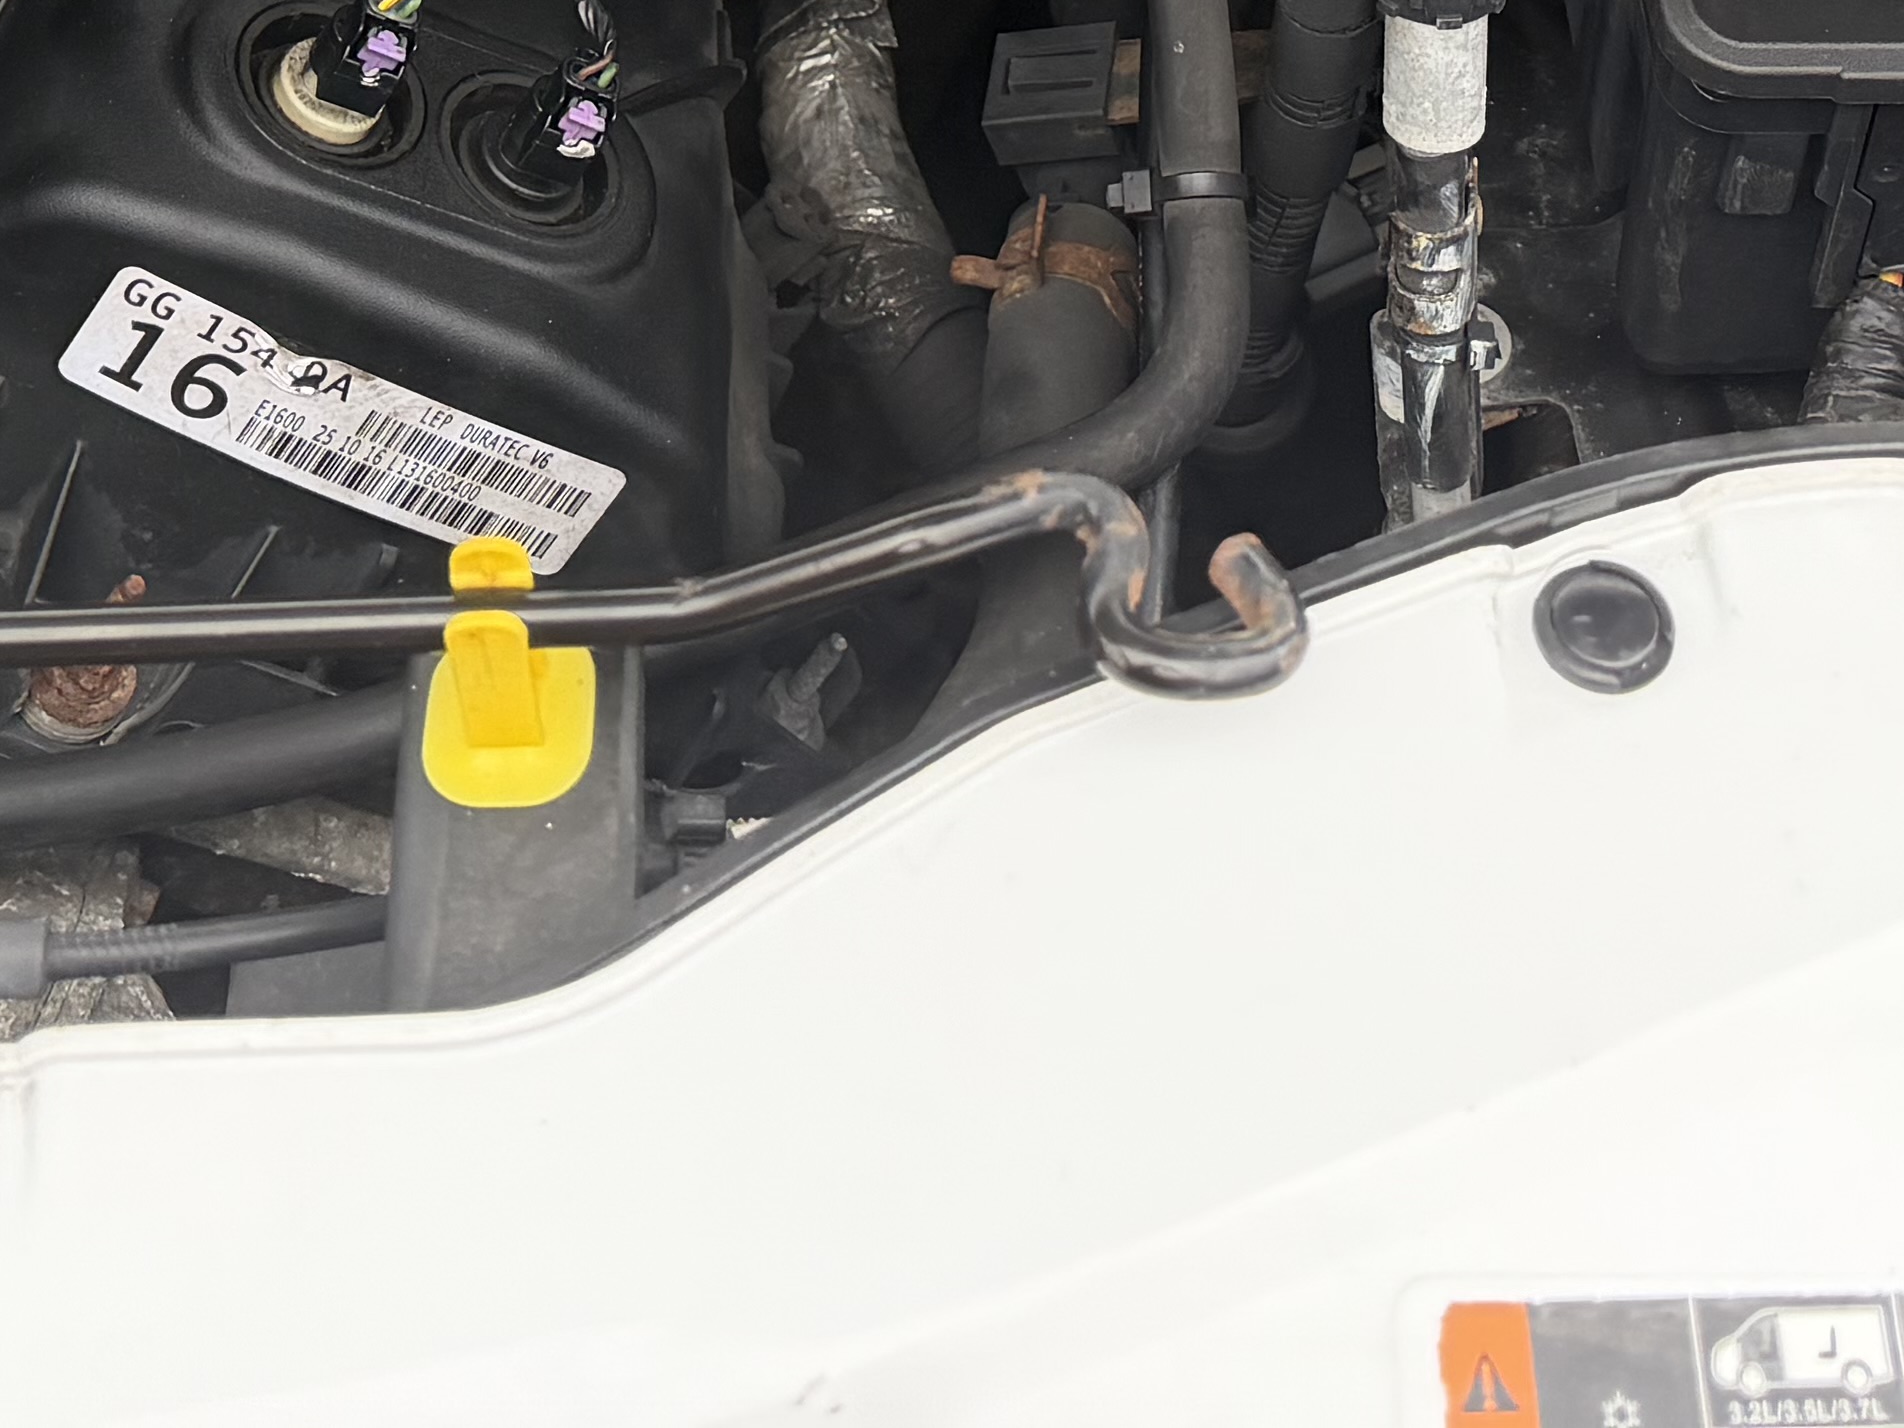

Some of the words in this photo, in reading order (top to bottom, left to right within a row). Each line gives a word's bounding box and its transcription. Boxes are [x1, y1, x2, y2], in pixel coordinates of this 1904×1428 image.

[124, 279, 181, 320] GG
[99, 321, 244, 418] 16
[253, 400, 305, 432] E1600
[313, 425, 337, 445] 25
[339, 436, 361, 455] 10
[363, 446, 386, 465] 16
[420, 407, 453, 429] LEP
[461, 424, 529, 460] DURATEC
[530, 450, 553, 469] V6
